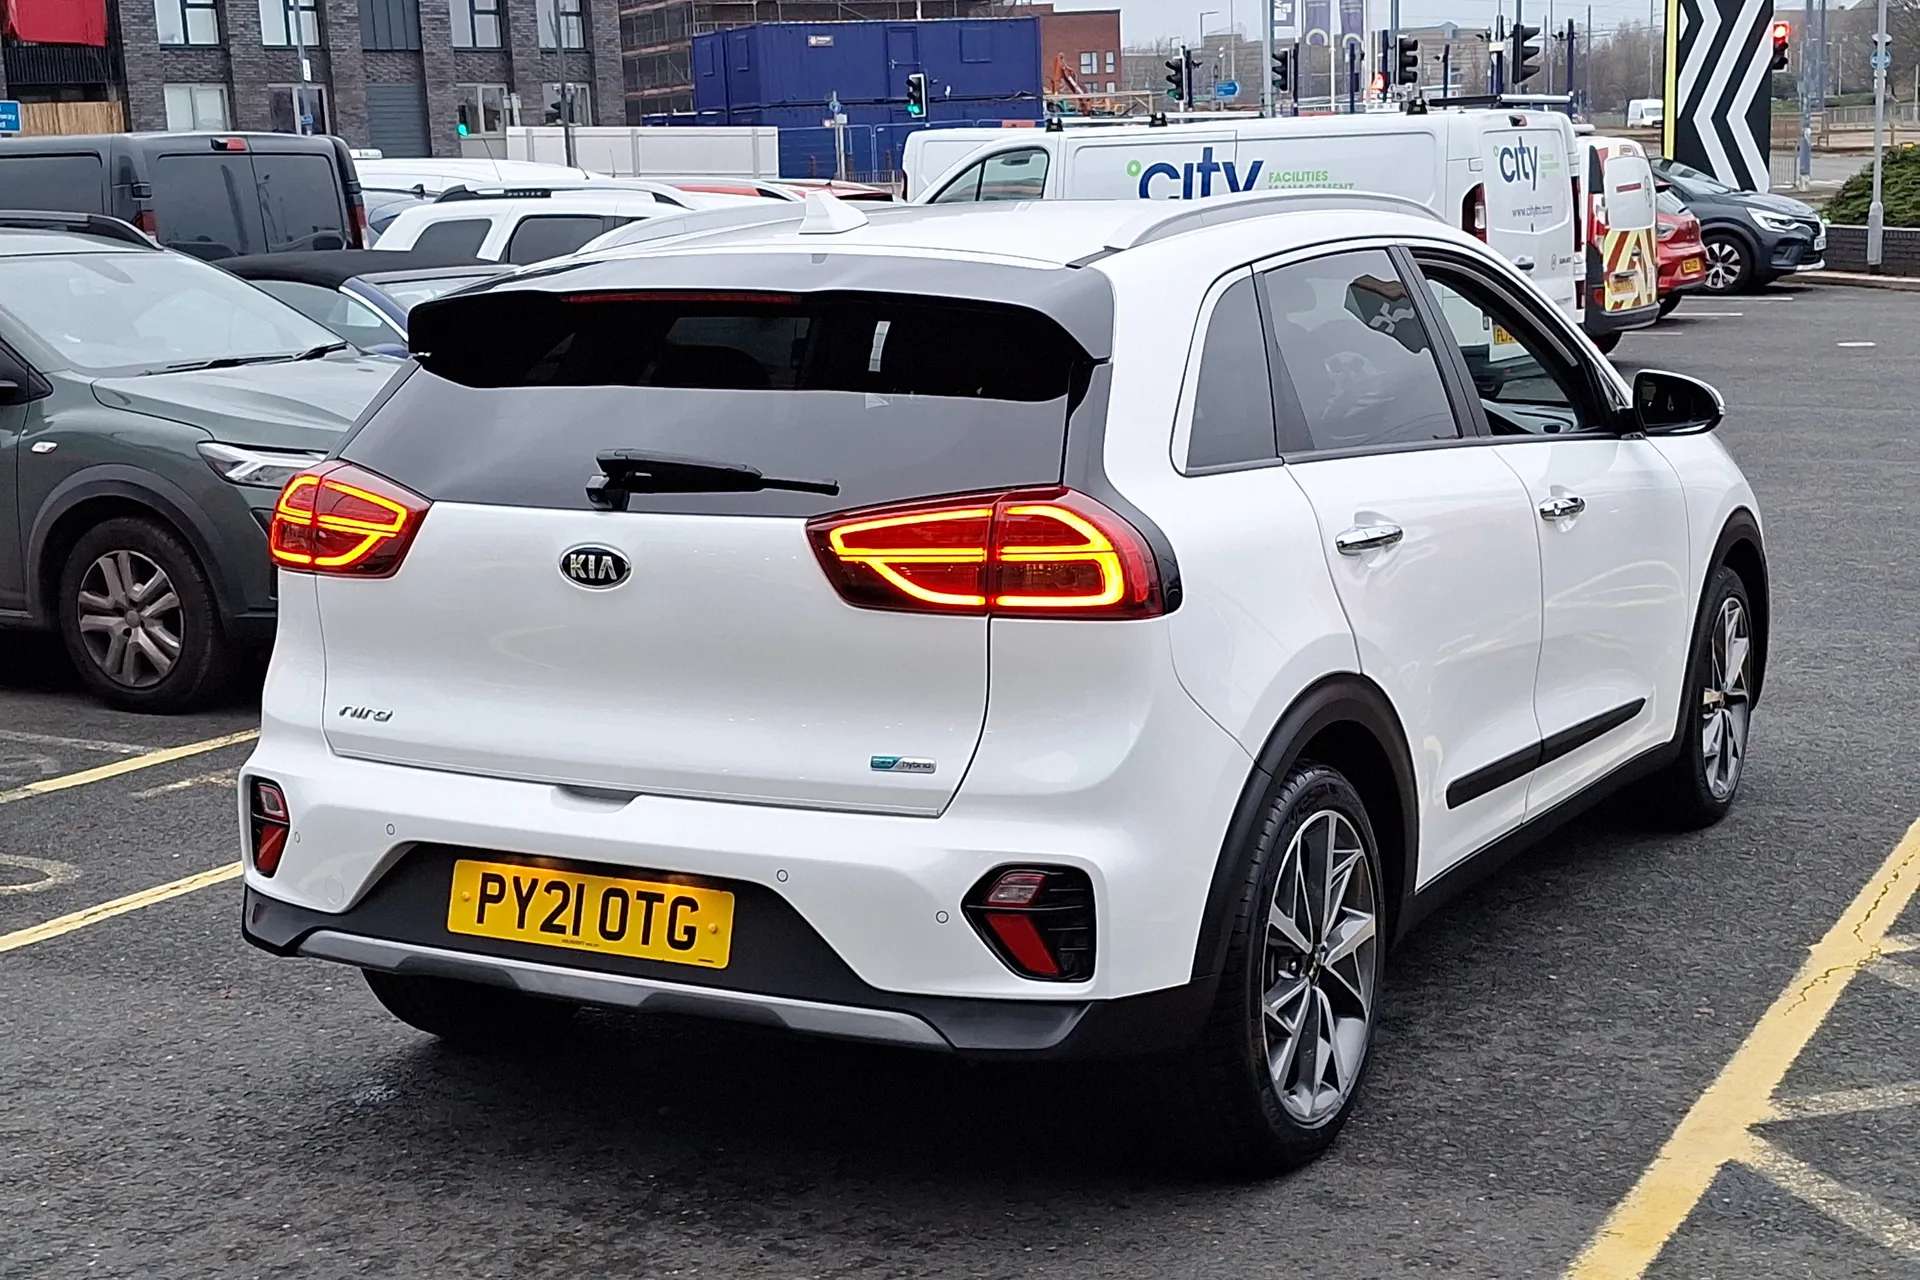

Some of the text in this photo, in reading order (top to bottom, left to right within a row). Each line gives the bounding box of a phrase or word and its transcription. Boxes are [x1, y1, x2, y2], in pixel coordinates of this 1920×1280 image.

[1138, 147, 1264, 199] city
[1269, 171, 1329, 183] FACILITIES
[1500, 136, 1538, 191] city
[569, 554, 617, 580] KIA
[476, 872, 699, 951] PY21 OTG
